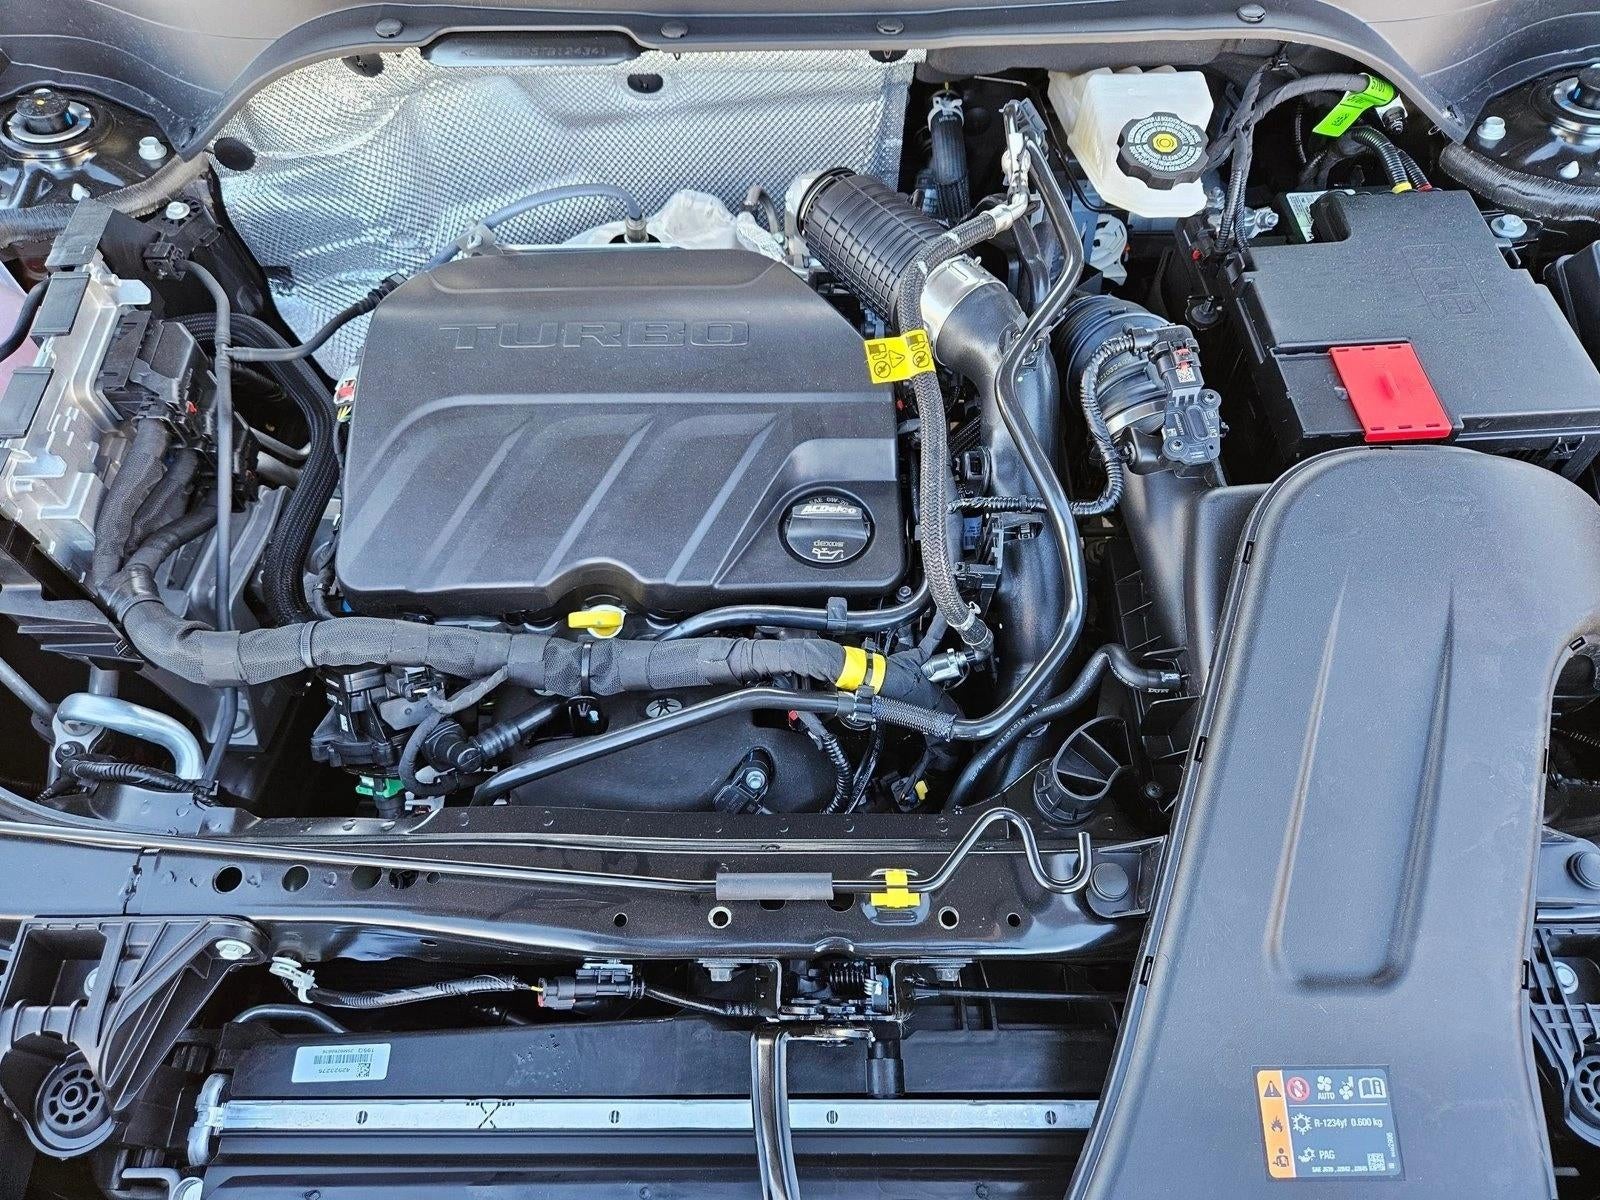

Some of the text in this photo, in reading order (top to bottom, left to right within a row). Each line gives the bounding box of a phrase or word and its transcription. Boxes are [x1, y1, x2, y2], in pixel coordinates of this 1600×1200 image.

[439, 320, 749, 350] TURBO
[800, 505, 857, 515] ACDelco
[1317, 1092, 1335, 1100] AUTO
[1313, 1118, 1383, 1129] R-1234yf 0.600 kg
[1319, 1150, 1336, 1159] PAG
